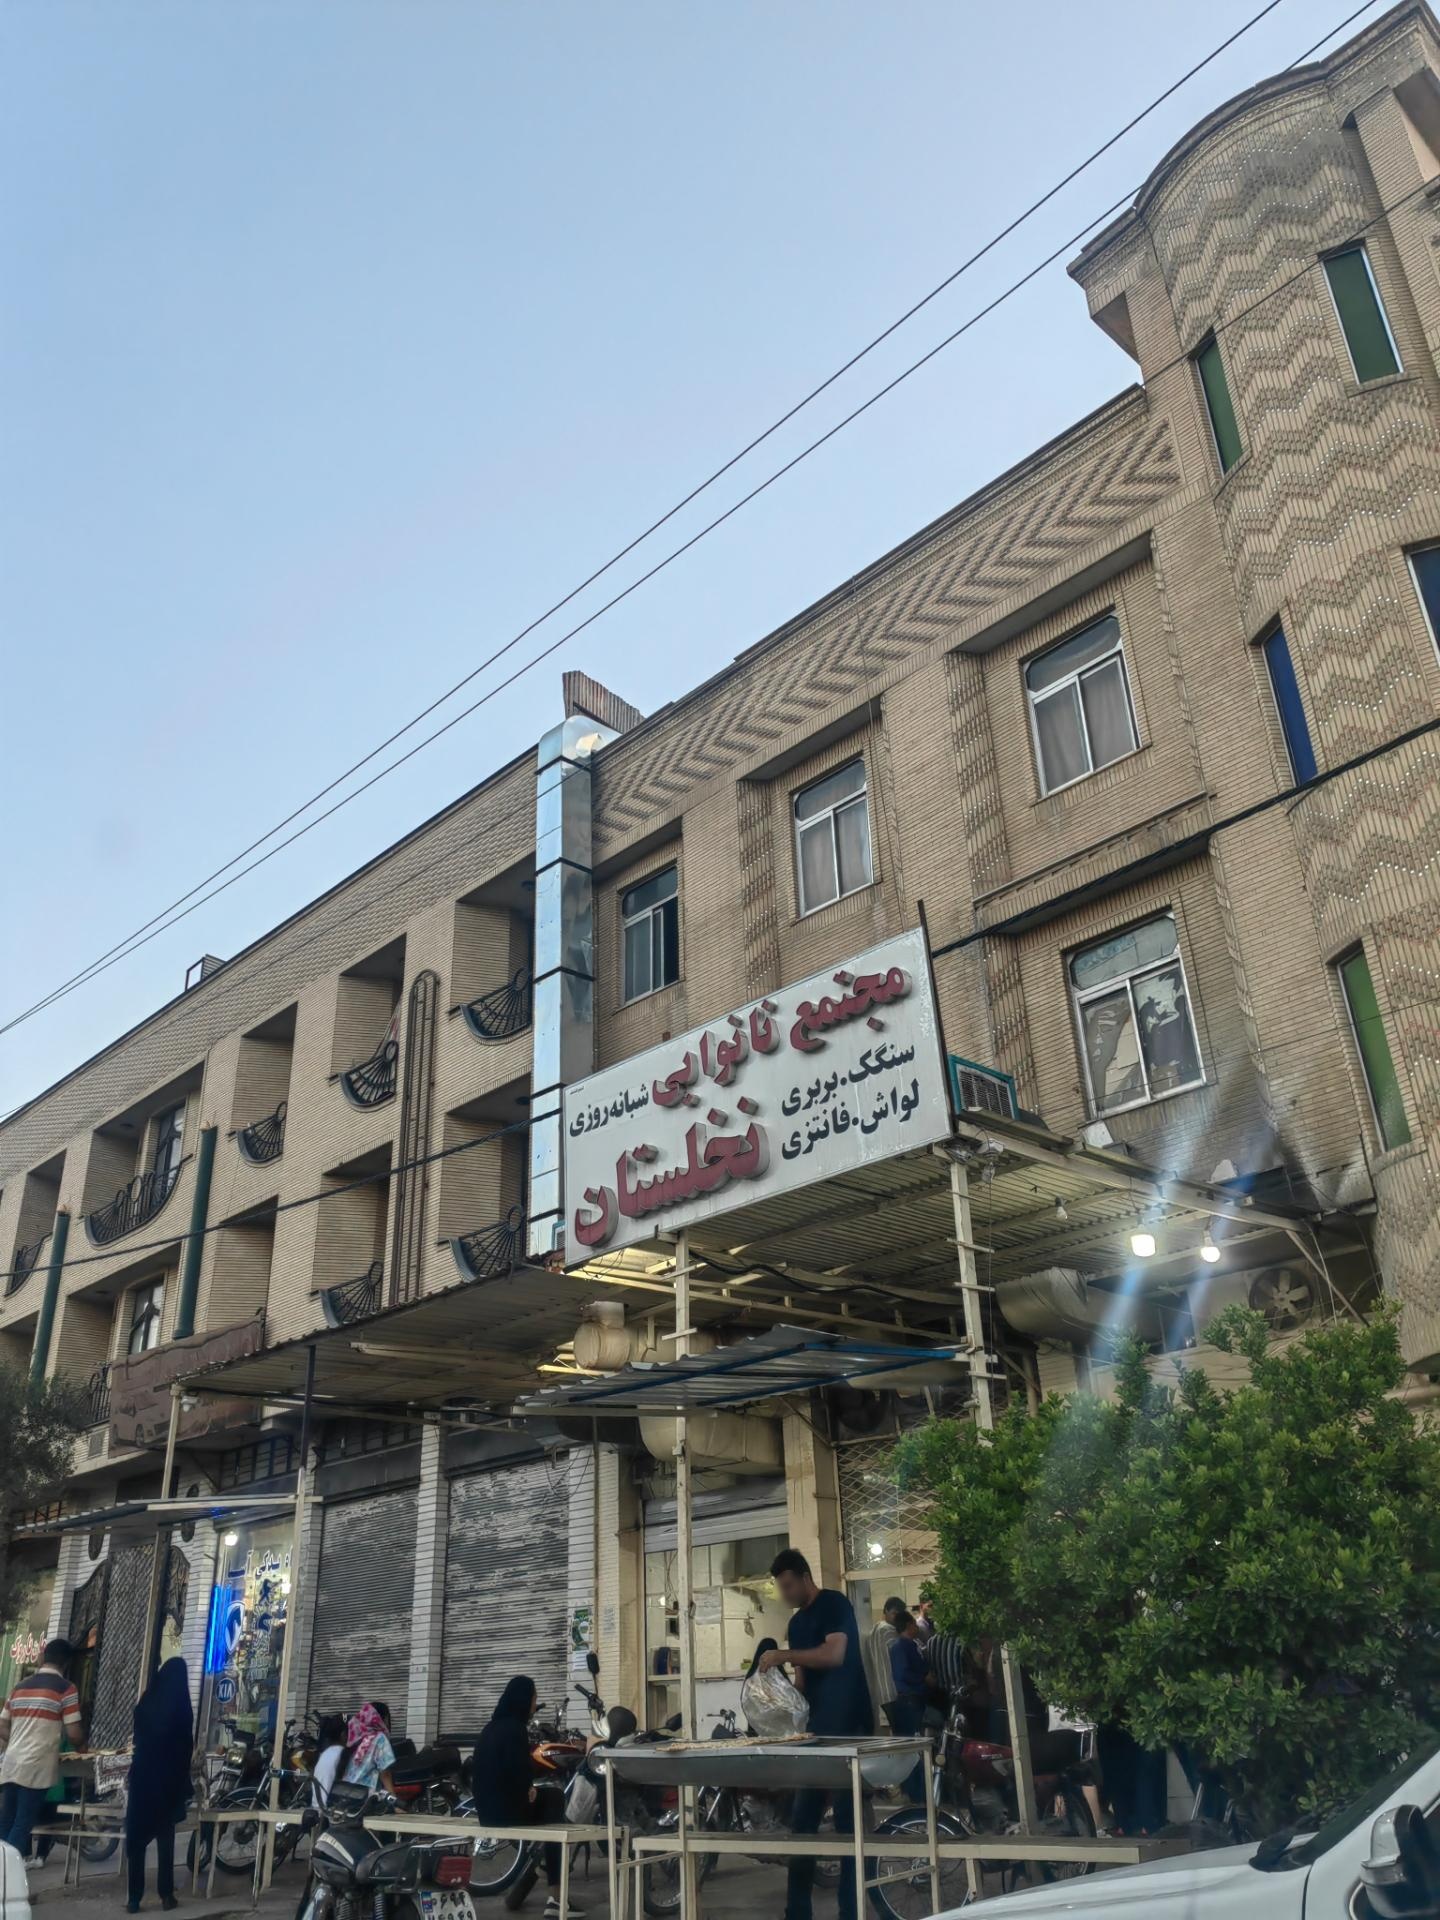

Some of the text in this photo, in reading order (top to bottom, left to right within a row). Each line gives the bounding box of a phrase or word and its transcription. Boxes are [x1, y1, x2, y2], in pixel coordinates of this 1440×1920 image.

[652, 1000, 780, 1108] نانوایی
[790, 966, 912, 1052] مجتمع
[575, 1096, 770, 1246] نخلستان
